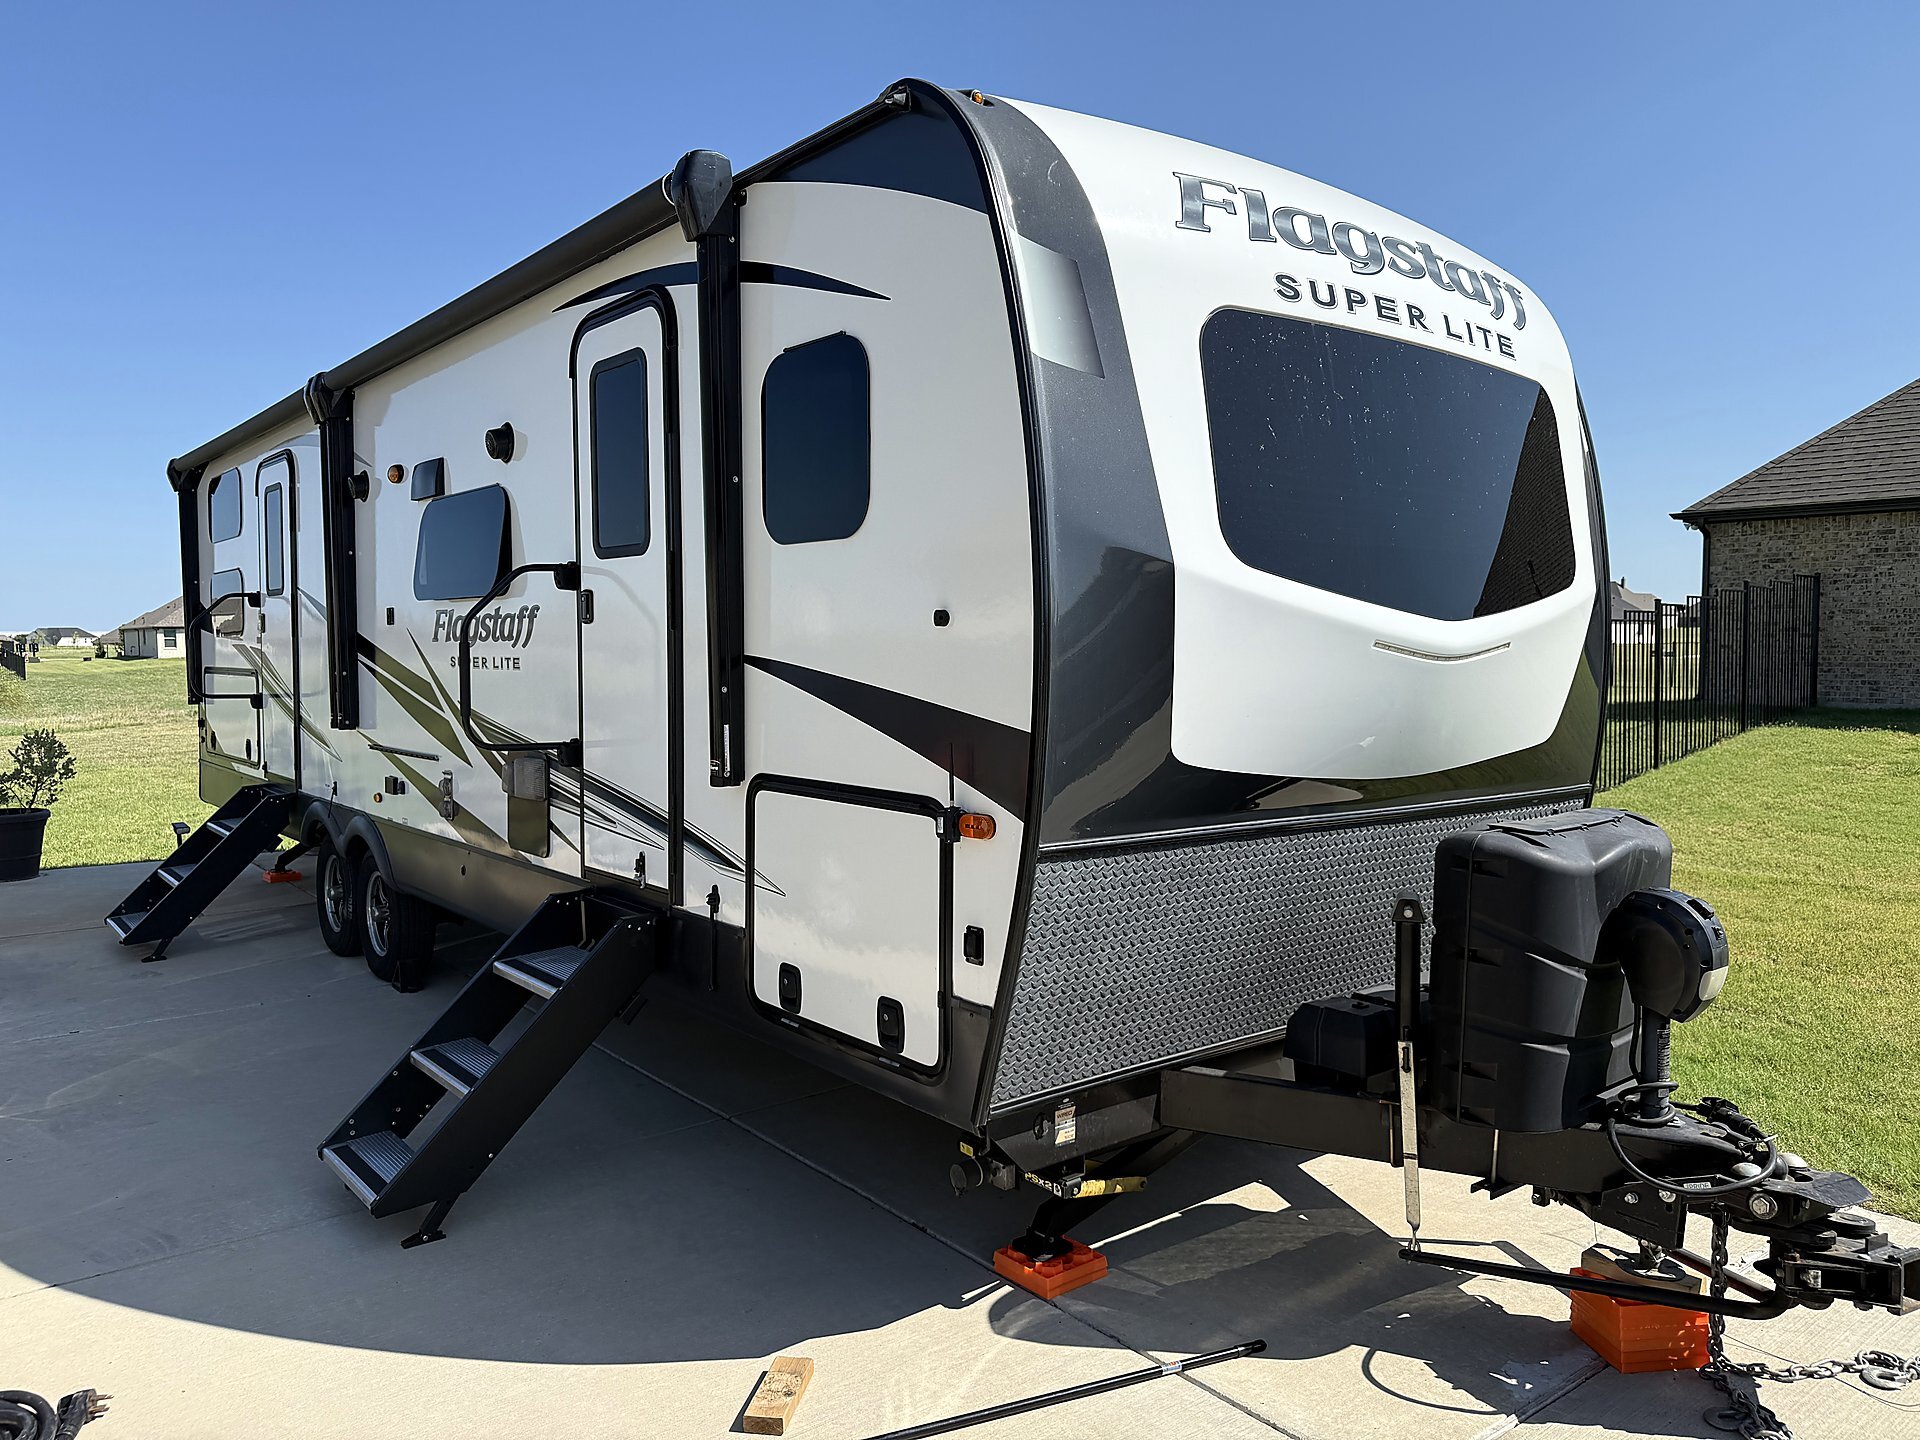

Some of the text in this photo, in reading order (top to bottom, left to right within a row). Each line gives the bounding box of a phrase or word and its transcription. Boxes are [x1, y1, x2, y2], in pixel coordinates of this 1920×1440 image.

[1172, 172, 1526, 330] Flagstaff
[1274, 272, 1516, 360] SUPER LITE
[432, 604, 541, 648] Flagstaff
[450, 656, 521, 670] SER LITE
